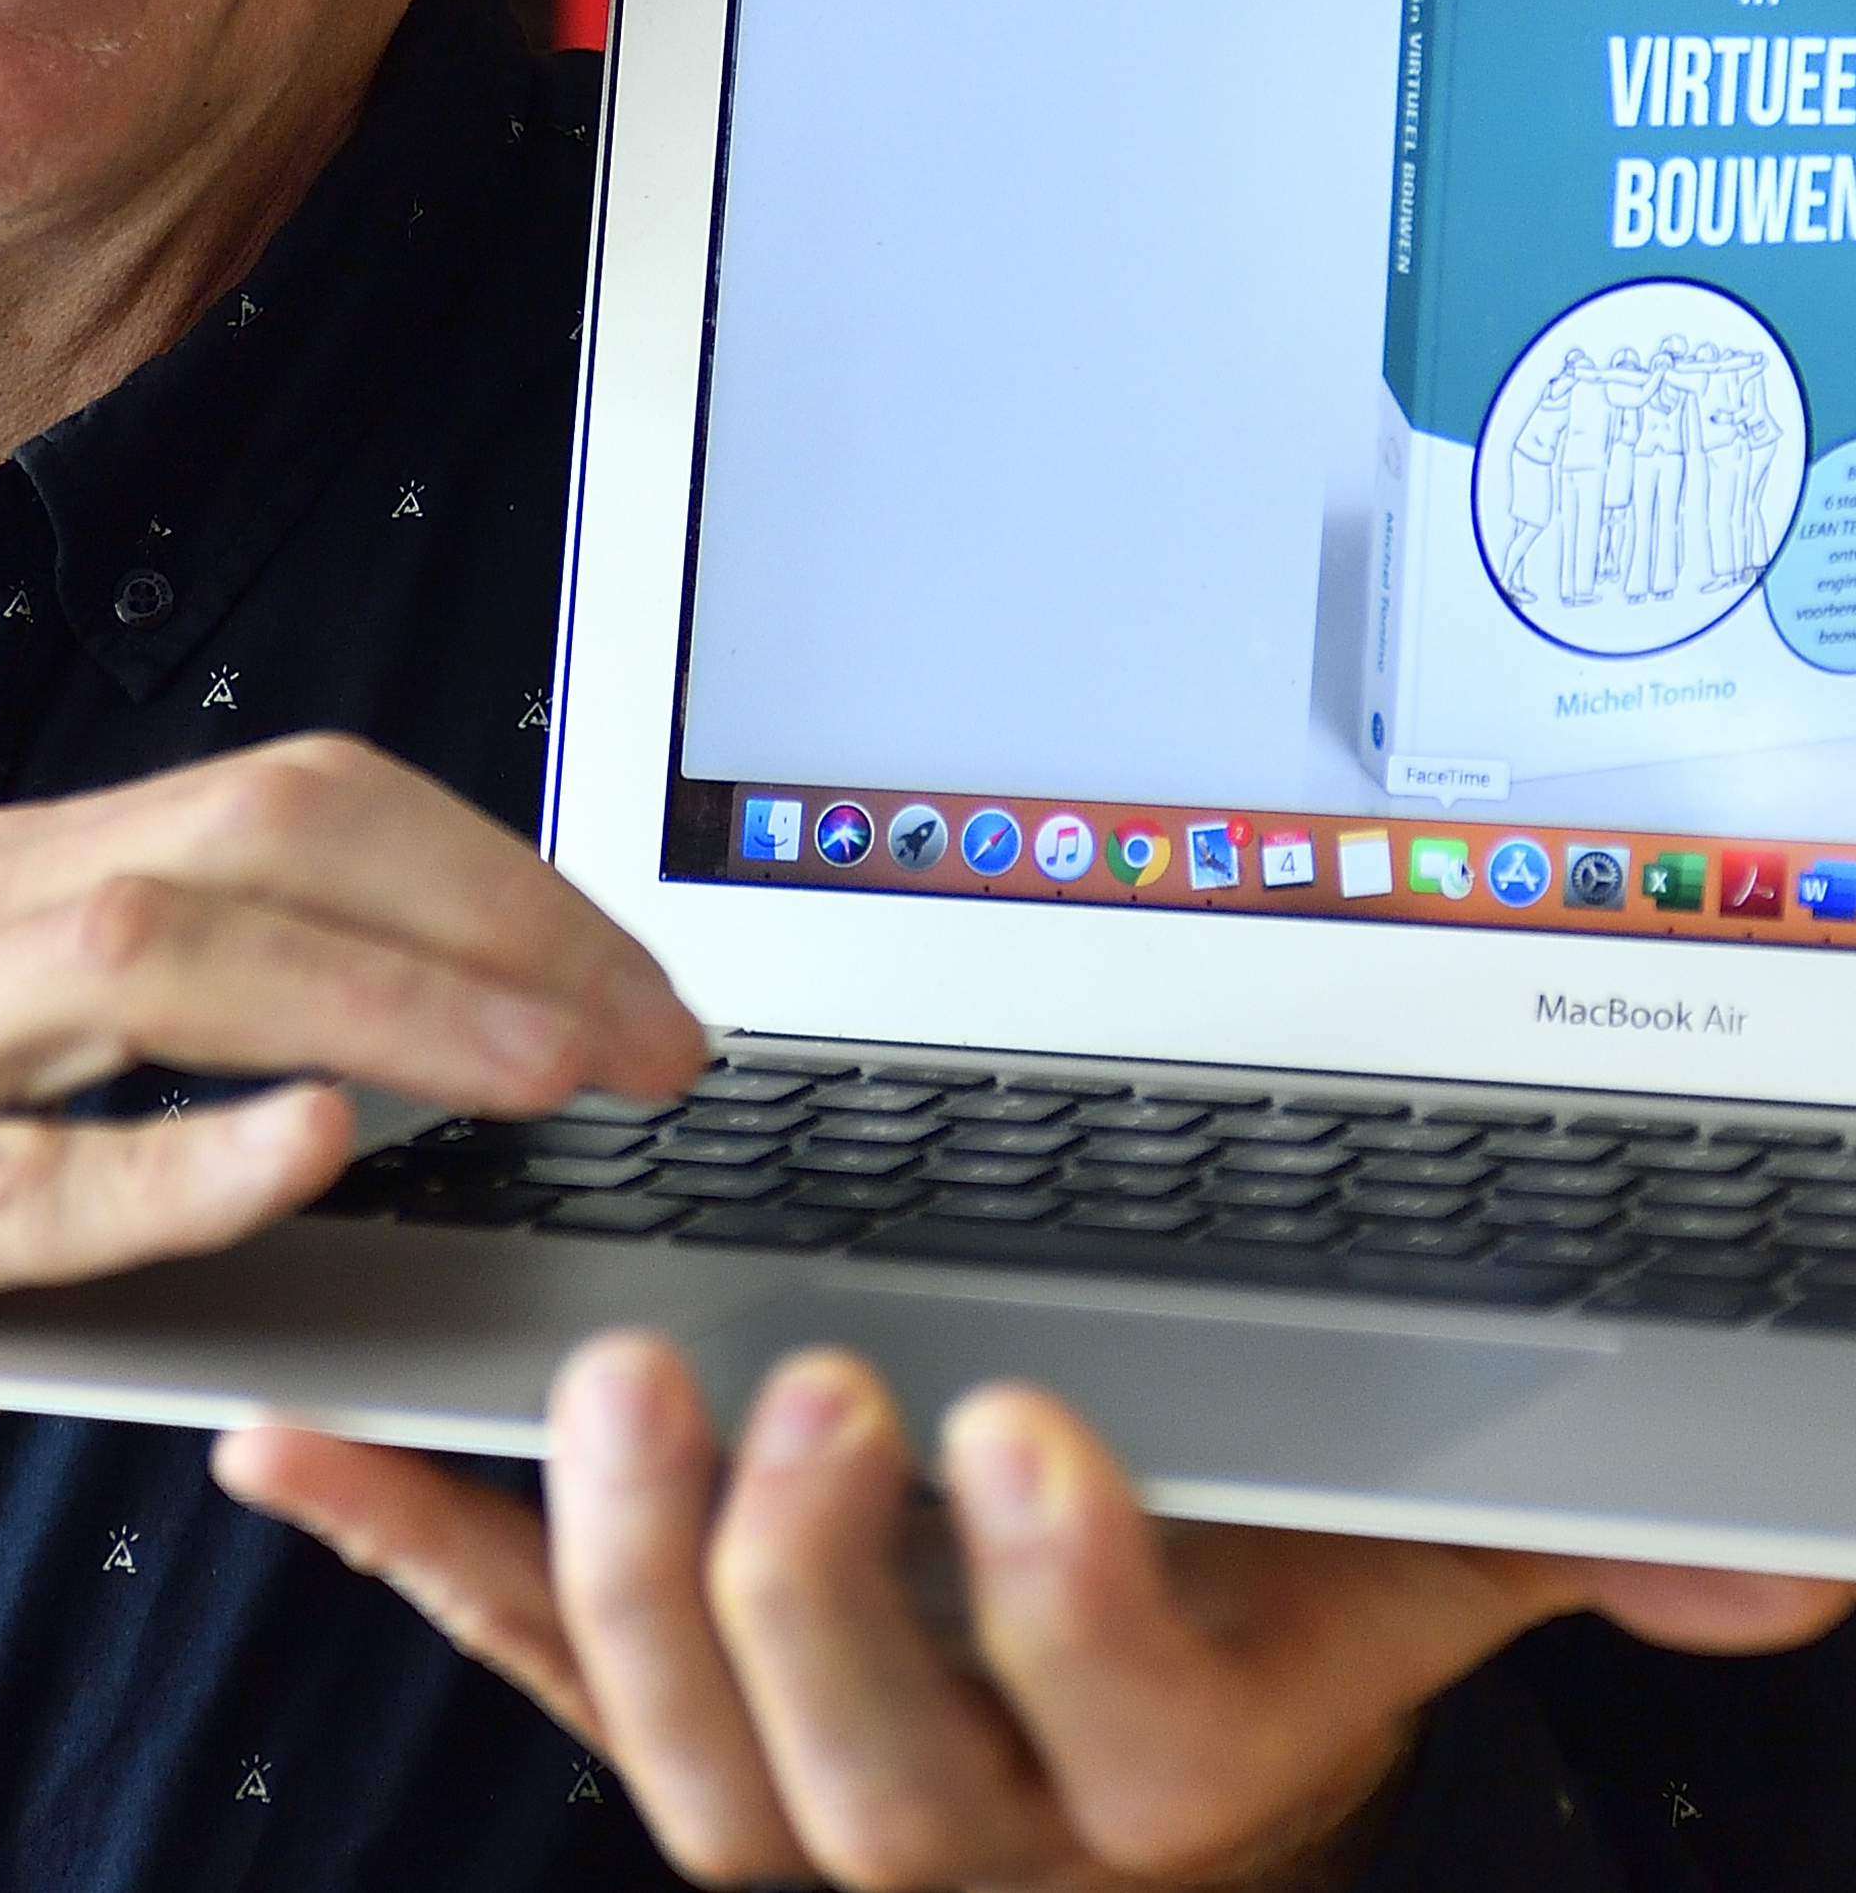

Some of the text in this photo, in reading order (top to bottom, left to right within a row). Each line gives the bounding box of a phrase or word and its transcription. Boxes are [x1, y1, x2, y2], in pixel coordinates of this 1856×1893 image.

[1403, 31, 1424, 155] VIRTUEEL
[1397, 161, 1416, 275] BOUWEN
[1800, 521, 1839, 539] LEAN
[1555, 680, 1737, 718] Michel Tonino
[1406, 767, 1491, 788] FaceTime
[1235, 826, 1244, 841] 2
[1280, 851, 1296, 877] 4
[1650, 869, 1668, 893] X
[1801, 879, 1828, 903] W
[1536, 993, 1749, 1036] MacBook Air
